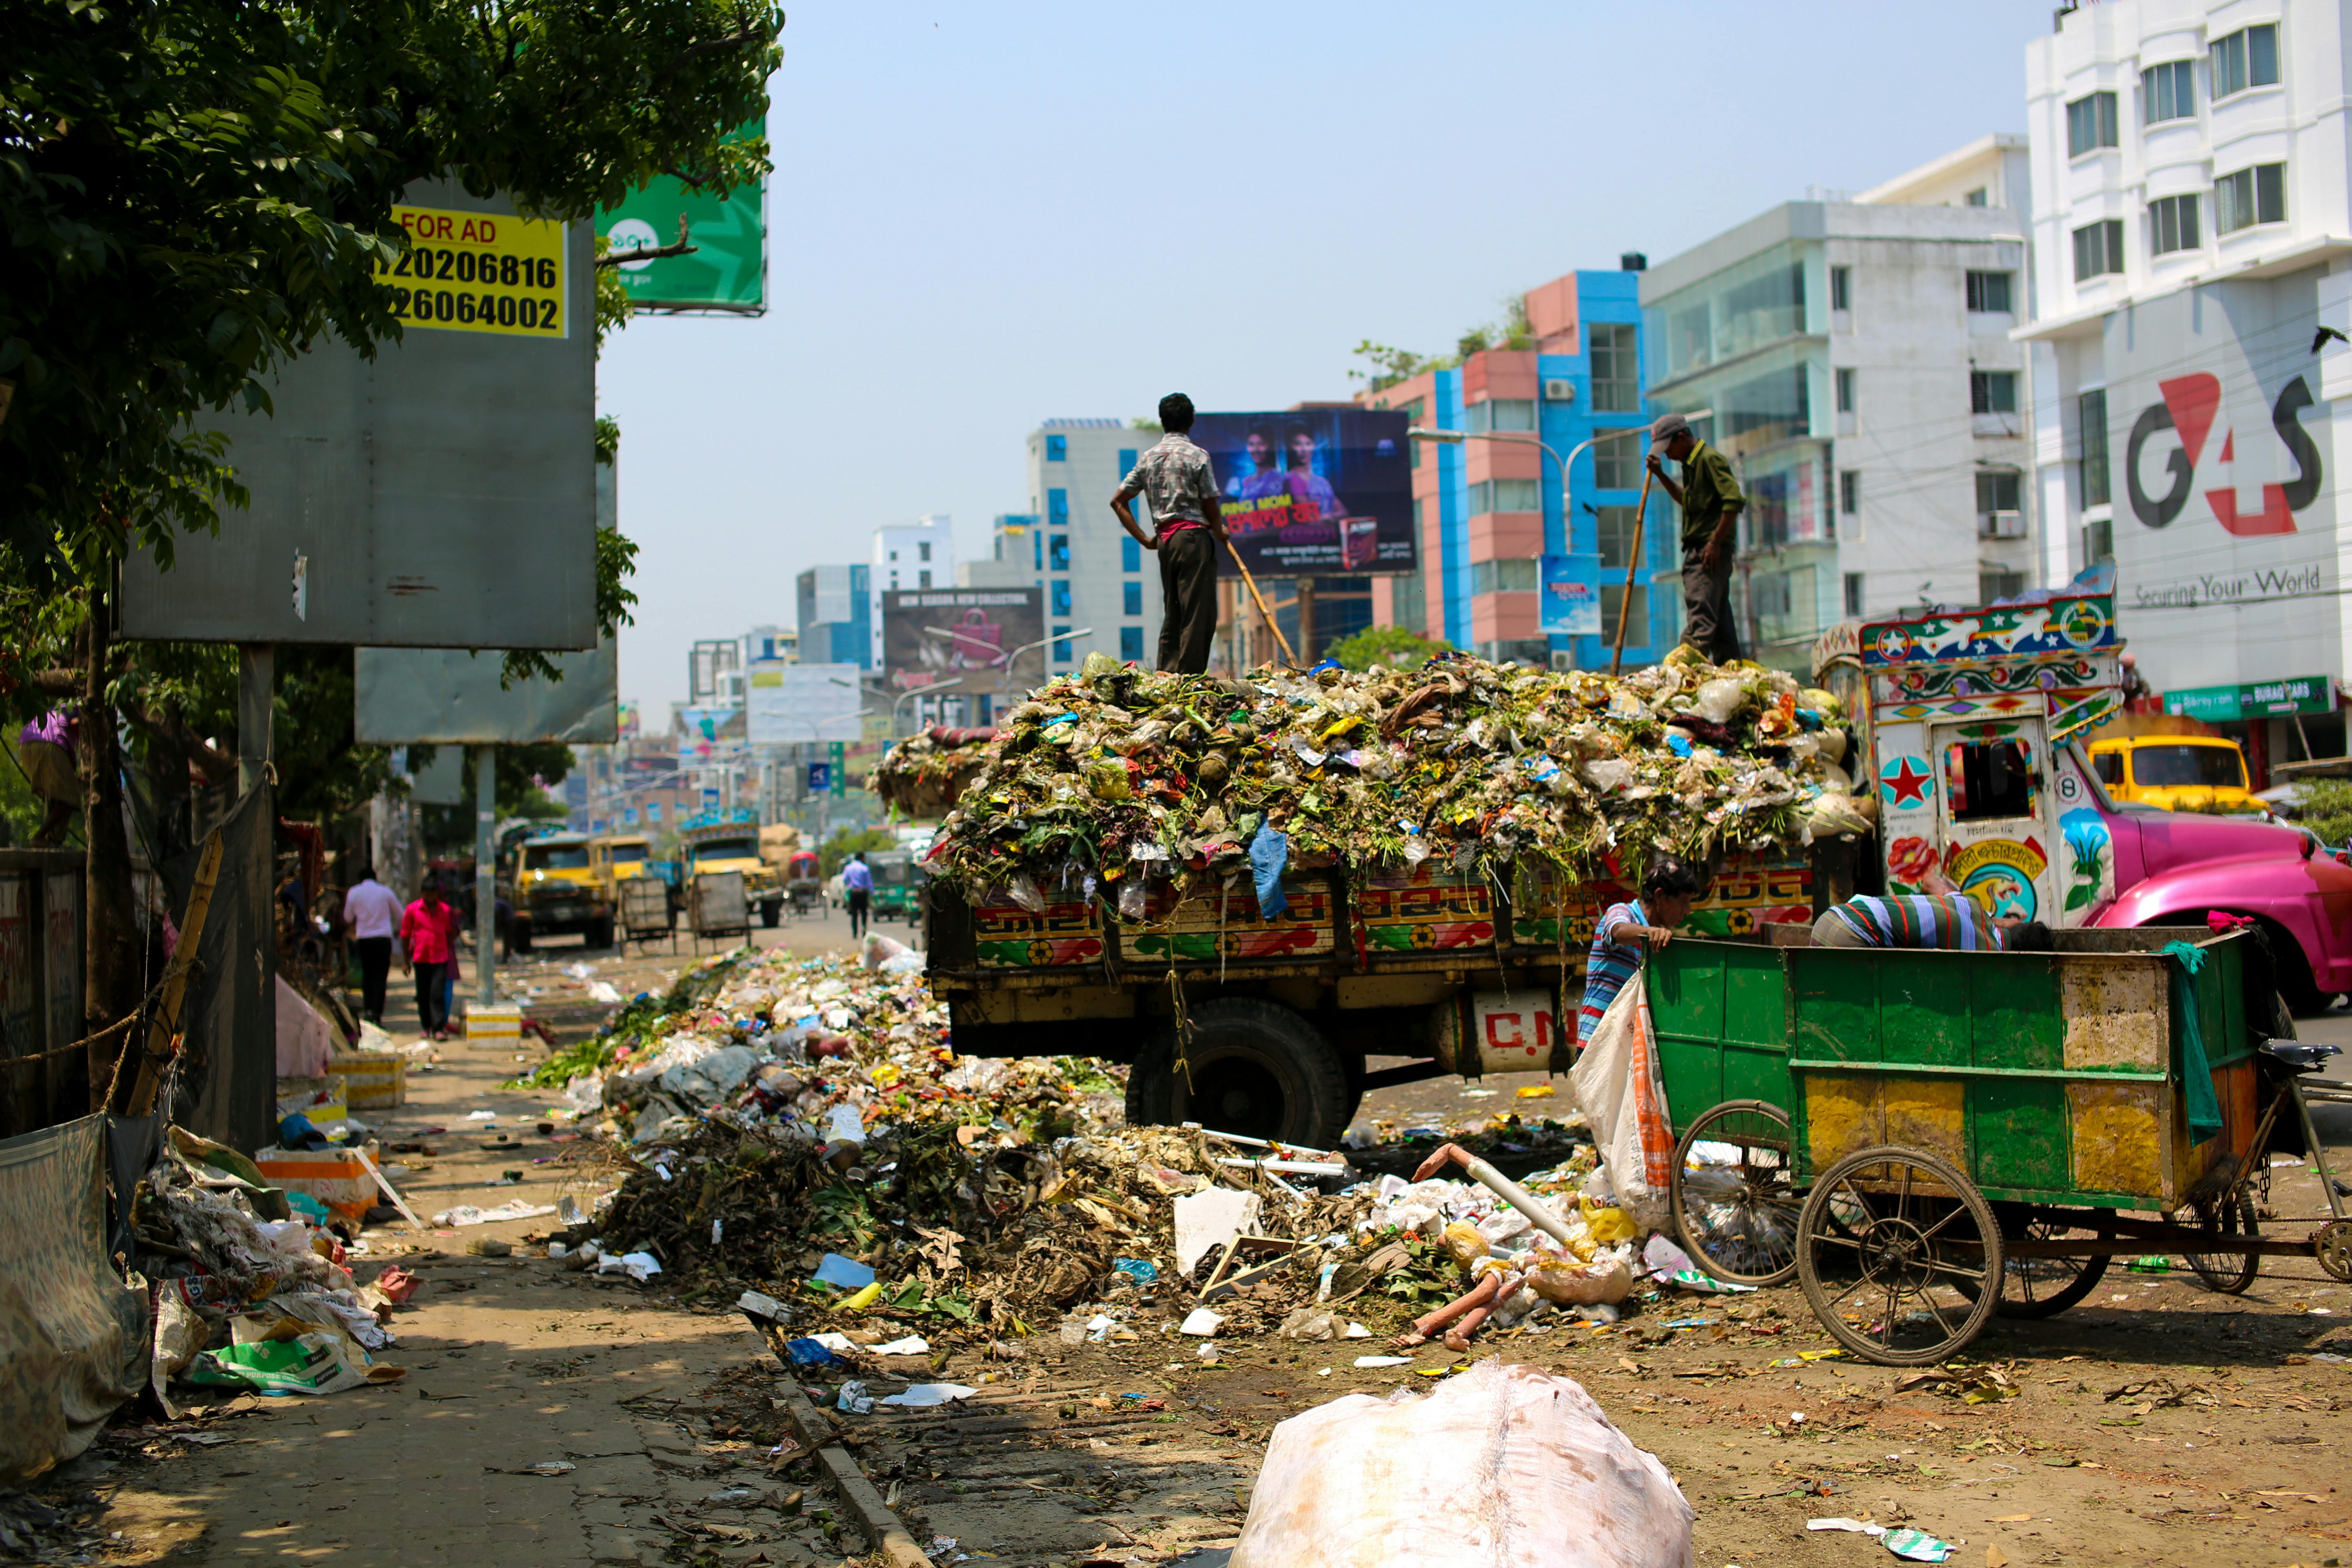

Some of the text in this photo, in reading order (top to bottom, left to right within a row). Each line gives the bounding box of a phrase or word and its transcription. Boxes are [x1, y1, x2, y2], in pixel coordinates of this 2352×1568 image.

[402, 213, 496, 243] FOR AD
[2126, 370, 2323, 539] G4S
[2199, 574, 2248, 599] Your
[2254, 564, 2320, 594] World
[246, 1371, 281, 1380] PURPOSE
